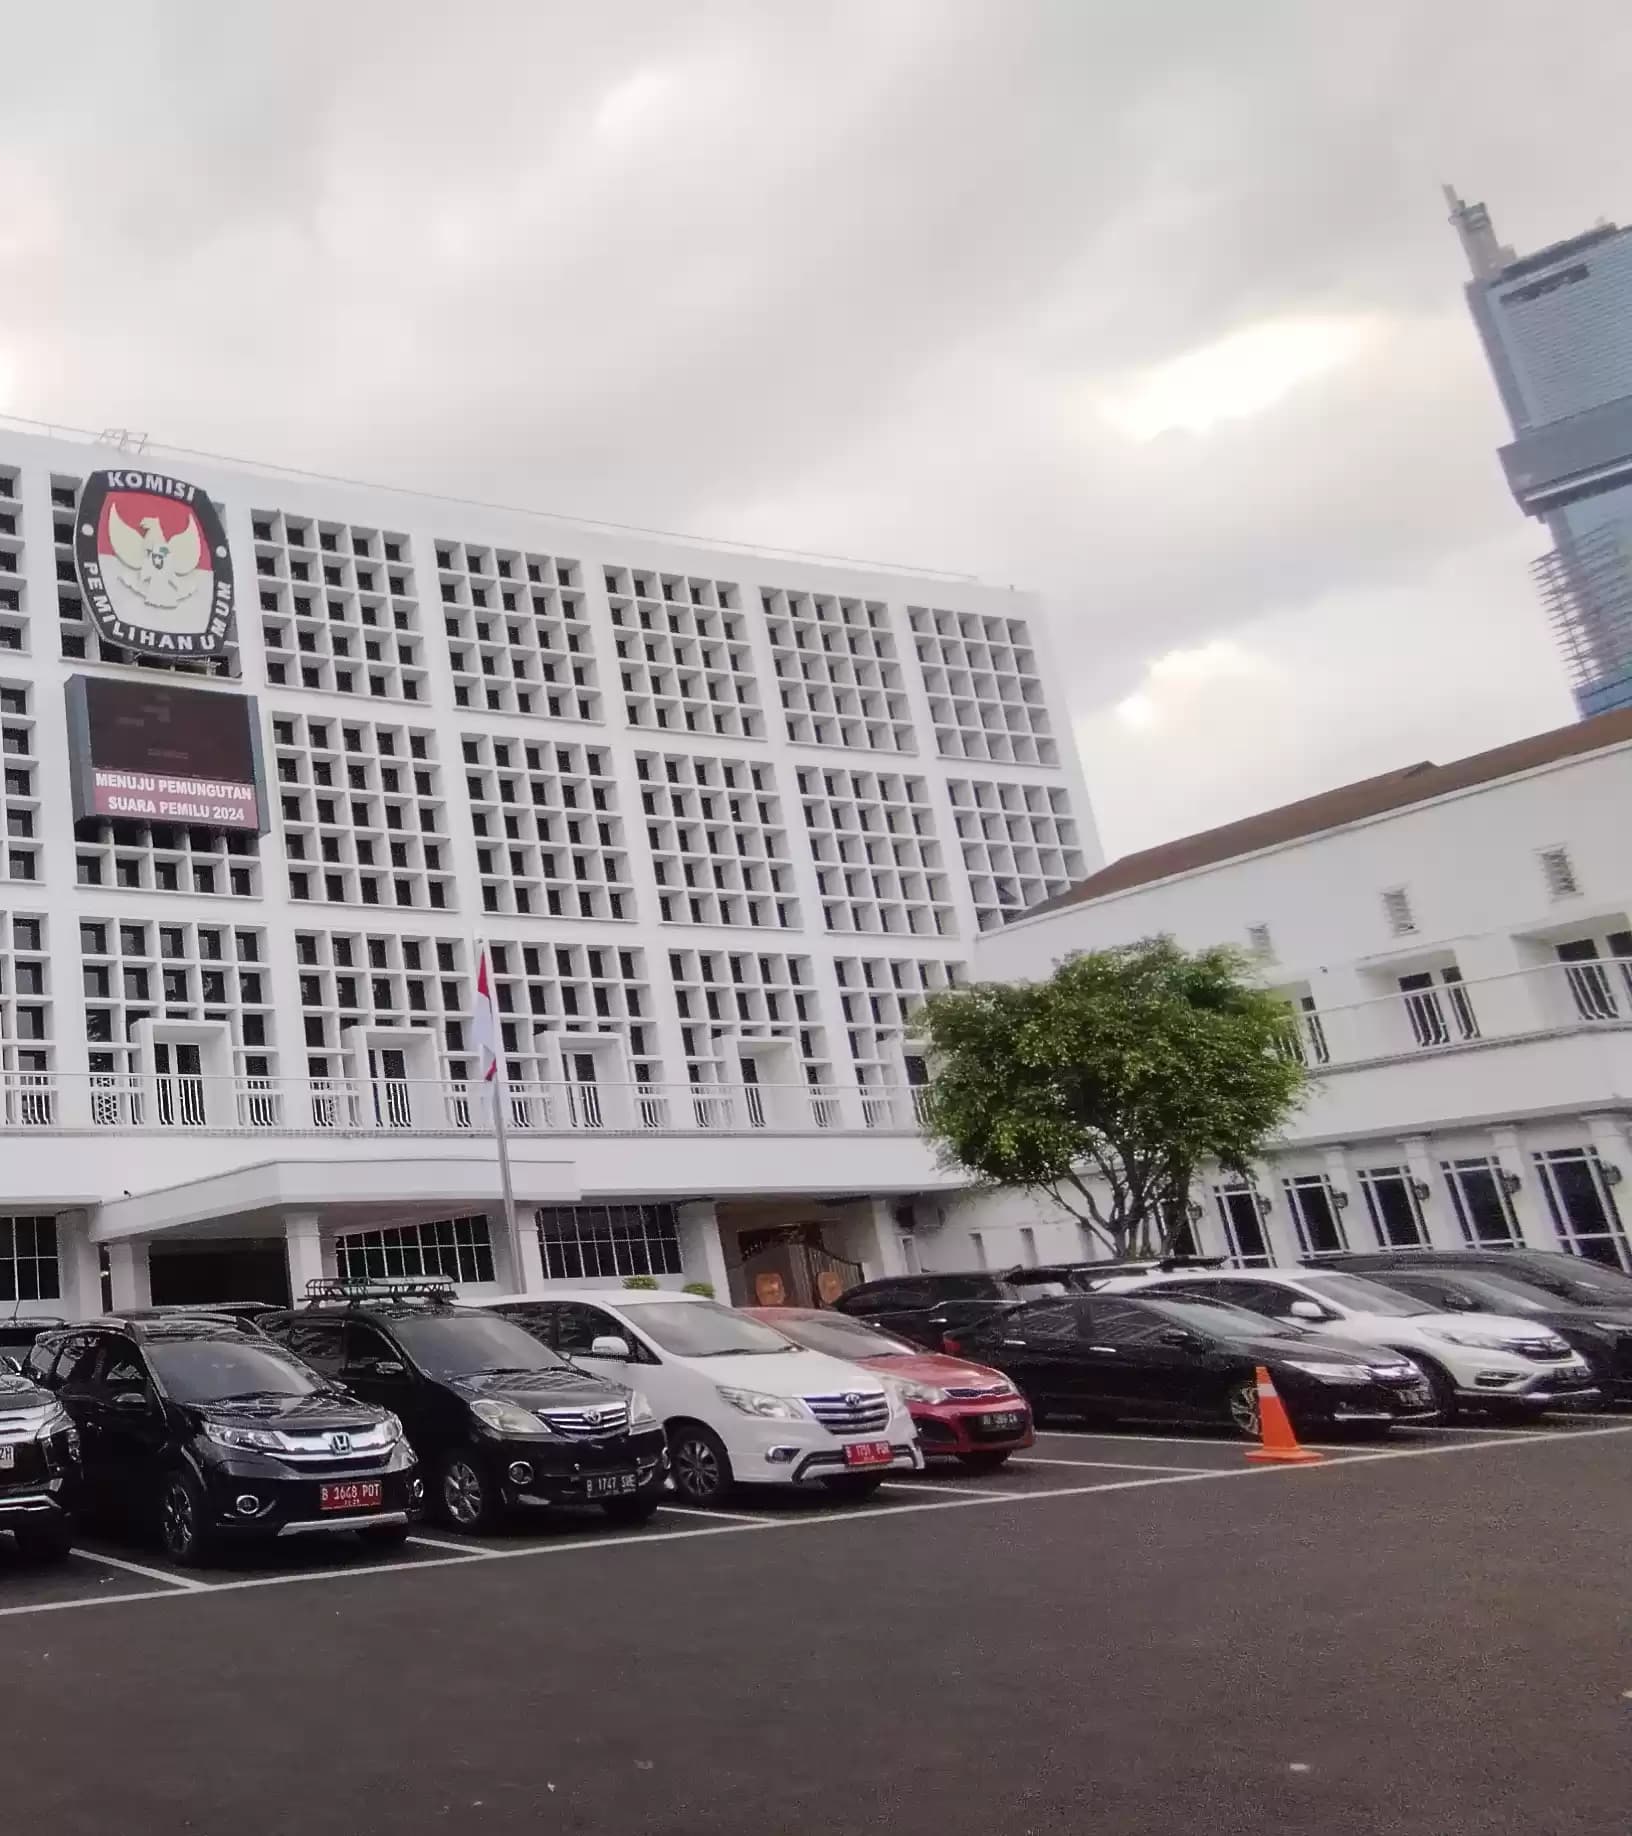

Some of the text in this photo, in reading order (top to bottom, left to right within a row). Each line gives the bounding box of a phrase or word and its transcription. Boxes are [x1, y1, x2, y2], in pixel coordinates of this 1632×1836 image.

[107, 471, 195, 501] KOMISI
[84, 561, 232, 651] PEMILIHAN UMUM
[95, 772, 252, 801] MENUJU PEMUNGUTAN
[108, 796, 245, 821] SUARA PEMILU 2024
[321, 1487, 329, 1501] B
